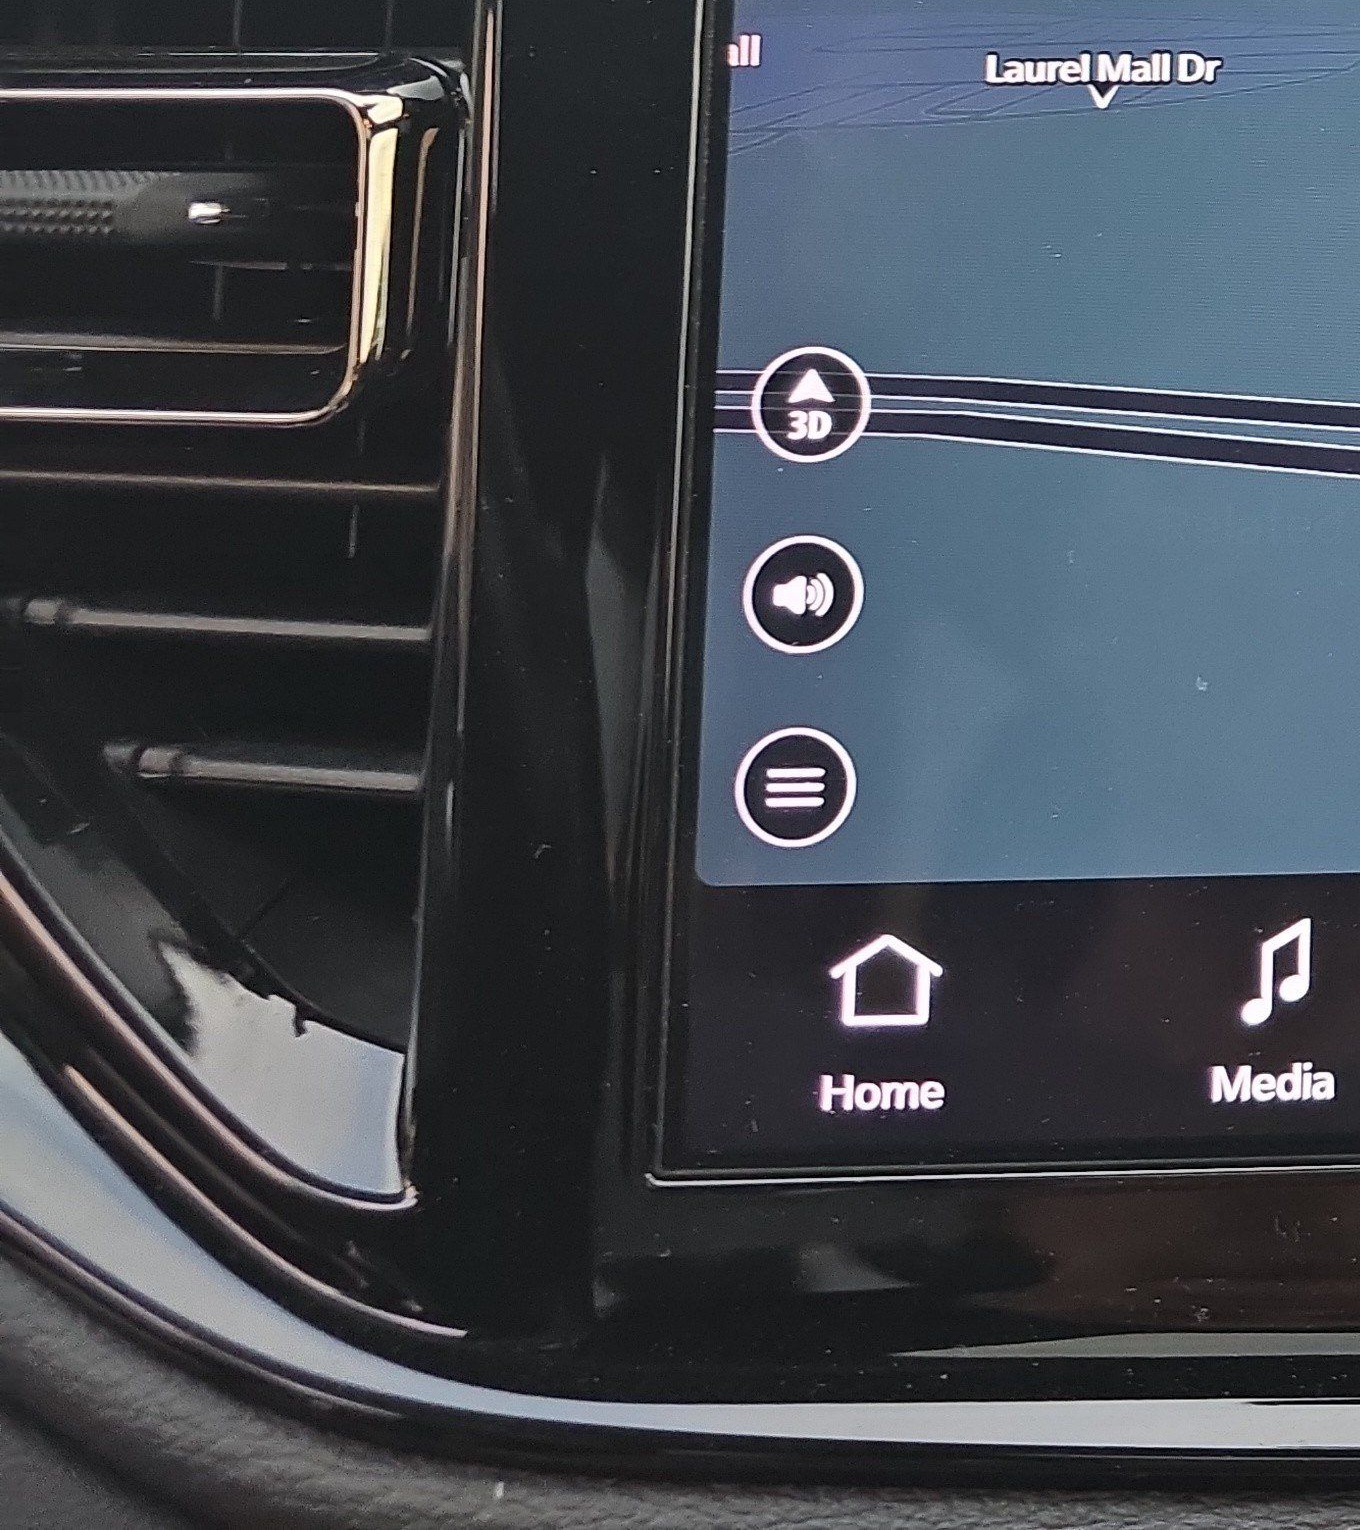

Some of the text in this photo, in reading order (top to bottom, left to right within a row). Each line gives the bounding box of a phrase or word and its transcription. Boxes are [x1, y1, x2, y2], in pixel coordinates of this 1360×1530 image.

[986, 52, 1221, 84] Laurel Mall Dr
[786, 411, 831, 441] 3D
[820, 1074, 945, 1112] Home
[1210, 1062, 1336, 1104] Media
